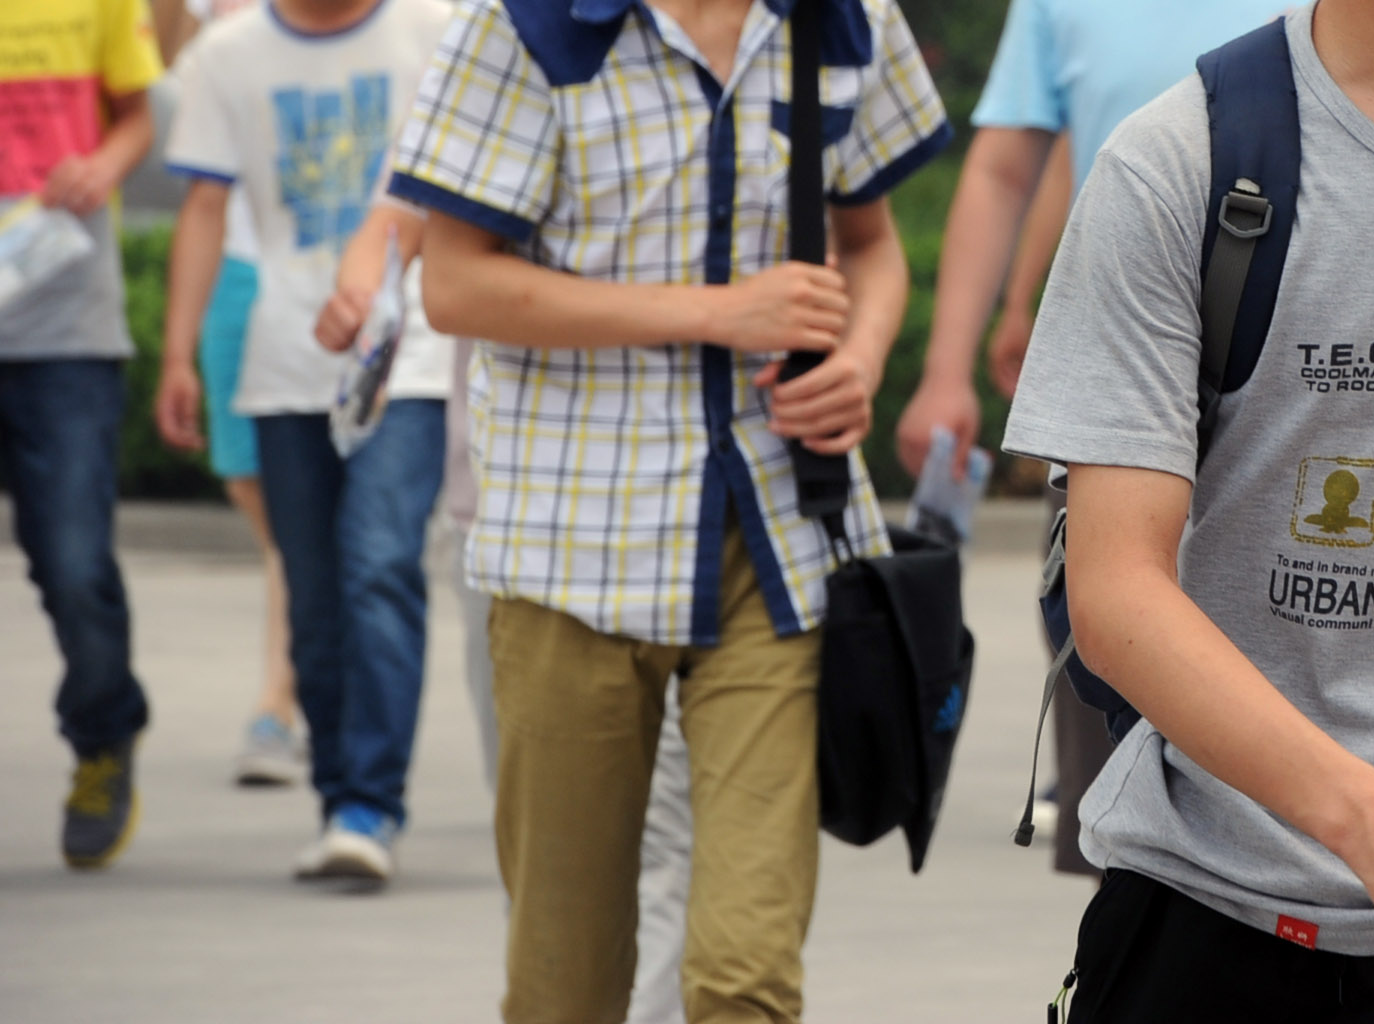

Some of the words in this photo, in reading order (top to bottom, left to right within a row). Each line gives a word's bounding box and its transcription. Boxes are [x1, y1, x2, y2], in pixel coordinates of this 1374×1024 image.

[1305, 380, 1331, 393] TO
[1276, 553, 1290, 567] To
[1292, 559, 1315, 572] and
[1332, 562, 1368, 576] brand
